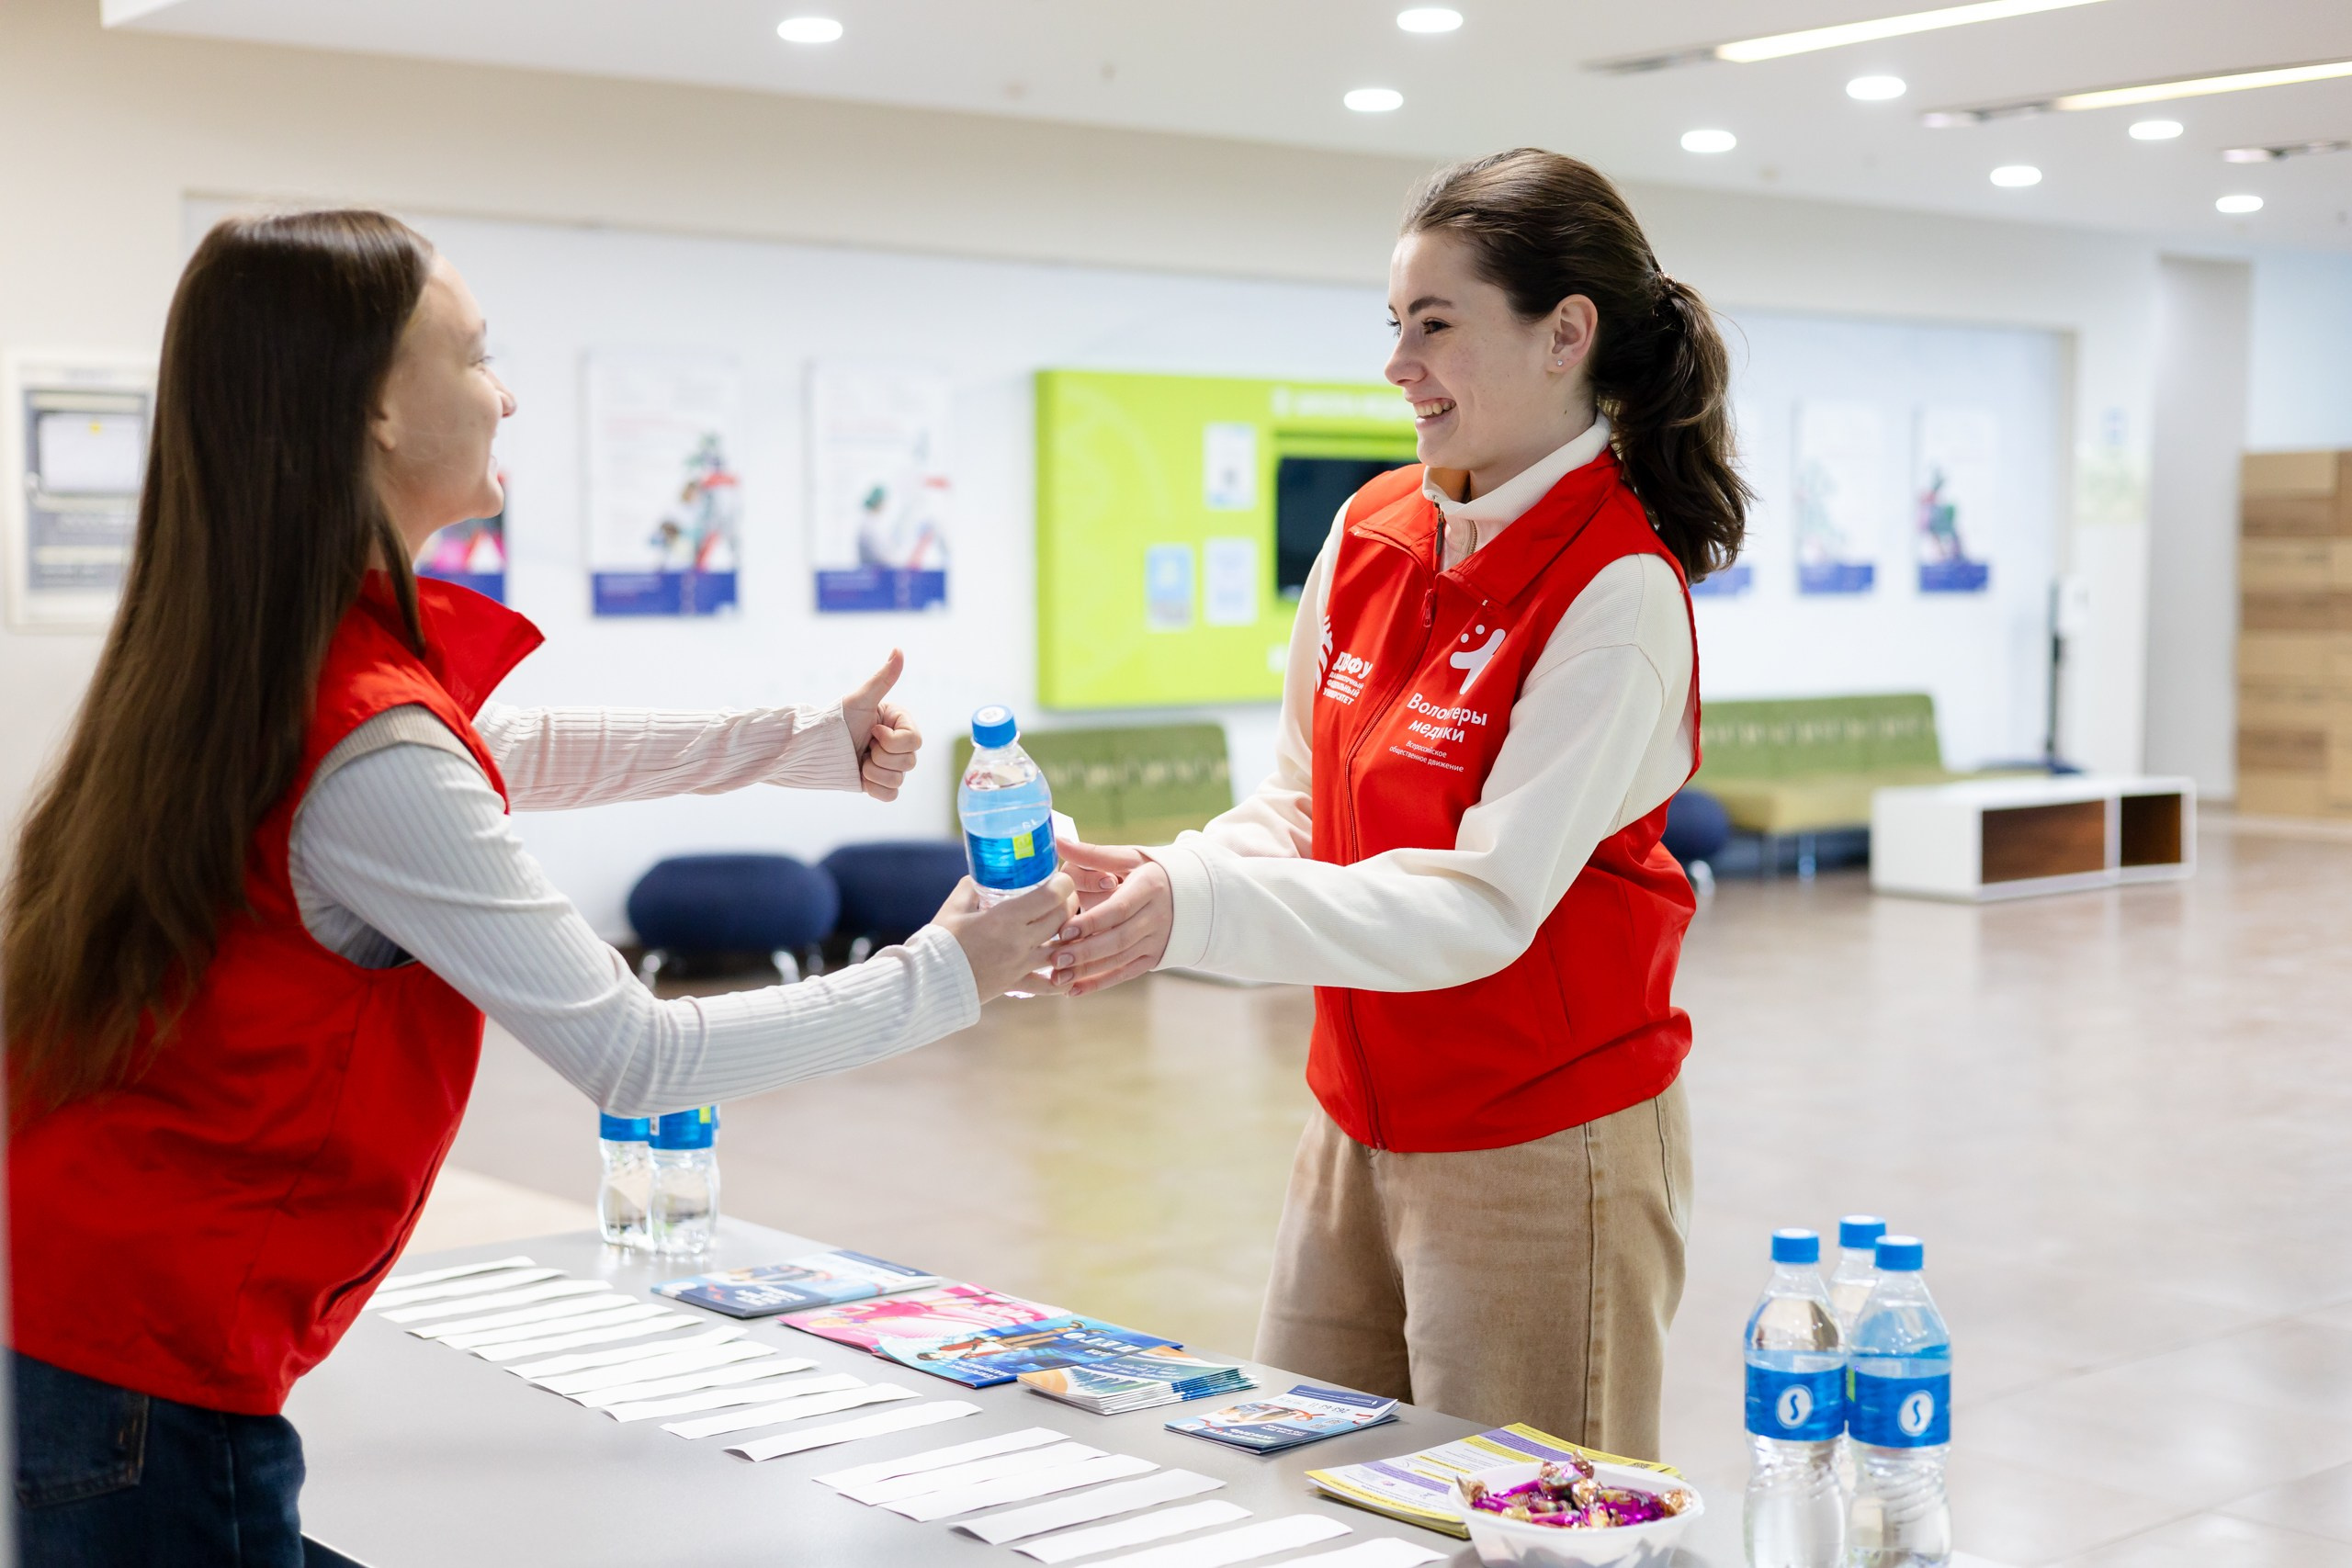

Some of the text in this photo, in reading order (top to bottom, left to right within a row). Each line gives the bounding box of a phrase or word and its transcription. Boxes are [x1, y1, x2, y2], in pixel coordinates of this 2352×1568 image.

[1407, 693, 1487, 727] Волоеры
[1389, 745, 1464, 773] общественное движение
[1406, 740, 1447, 759] Всероссийское
